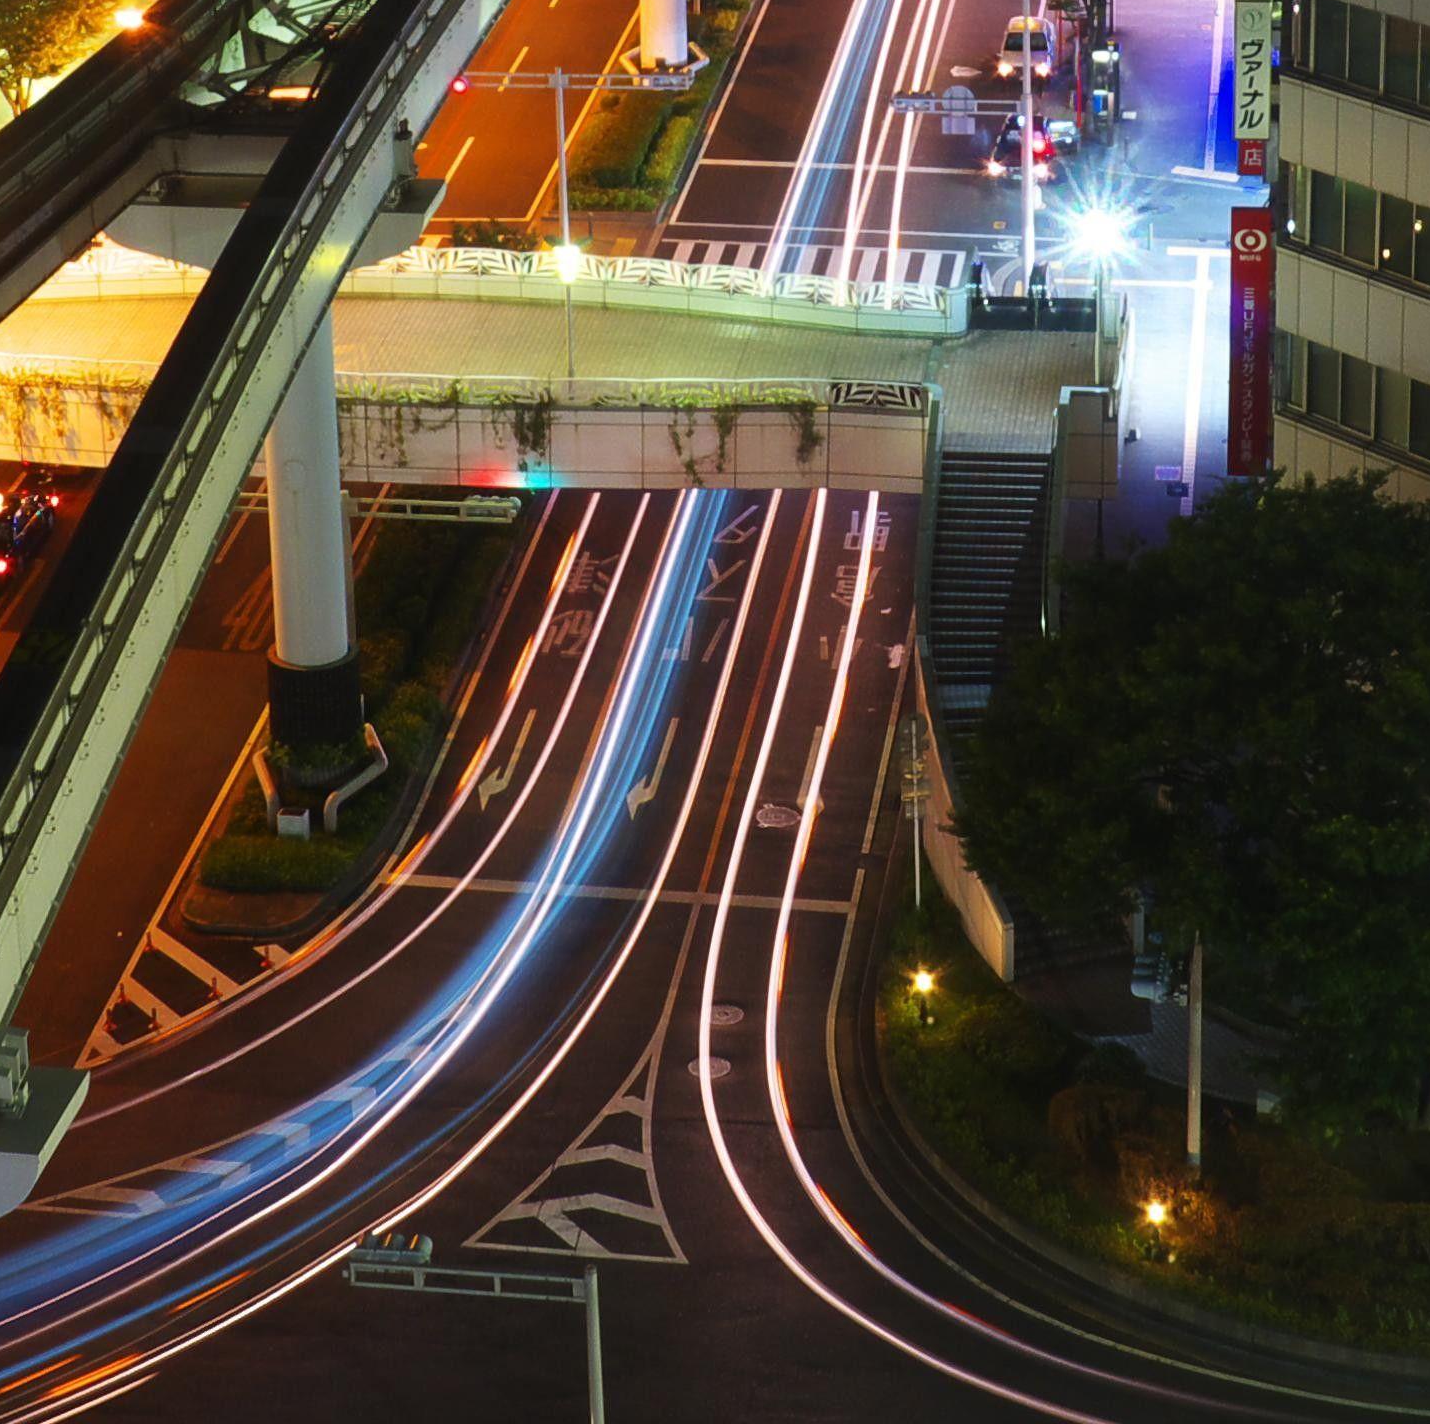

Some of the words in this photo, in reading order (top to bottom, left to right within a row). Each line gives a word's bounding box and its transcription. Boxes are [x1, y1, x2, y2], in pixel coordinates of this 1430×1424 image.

[1239, 38, 1264, 130] ヴァーナル
